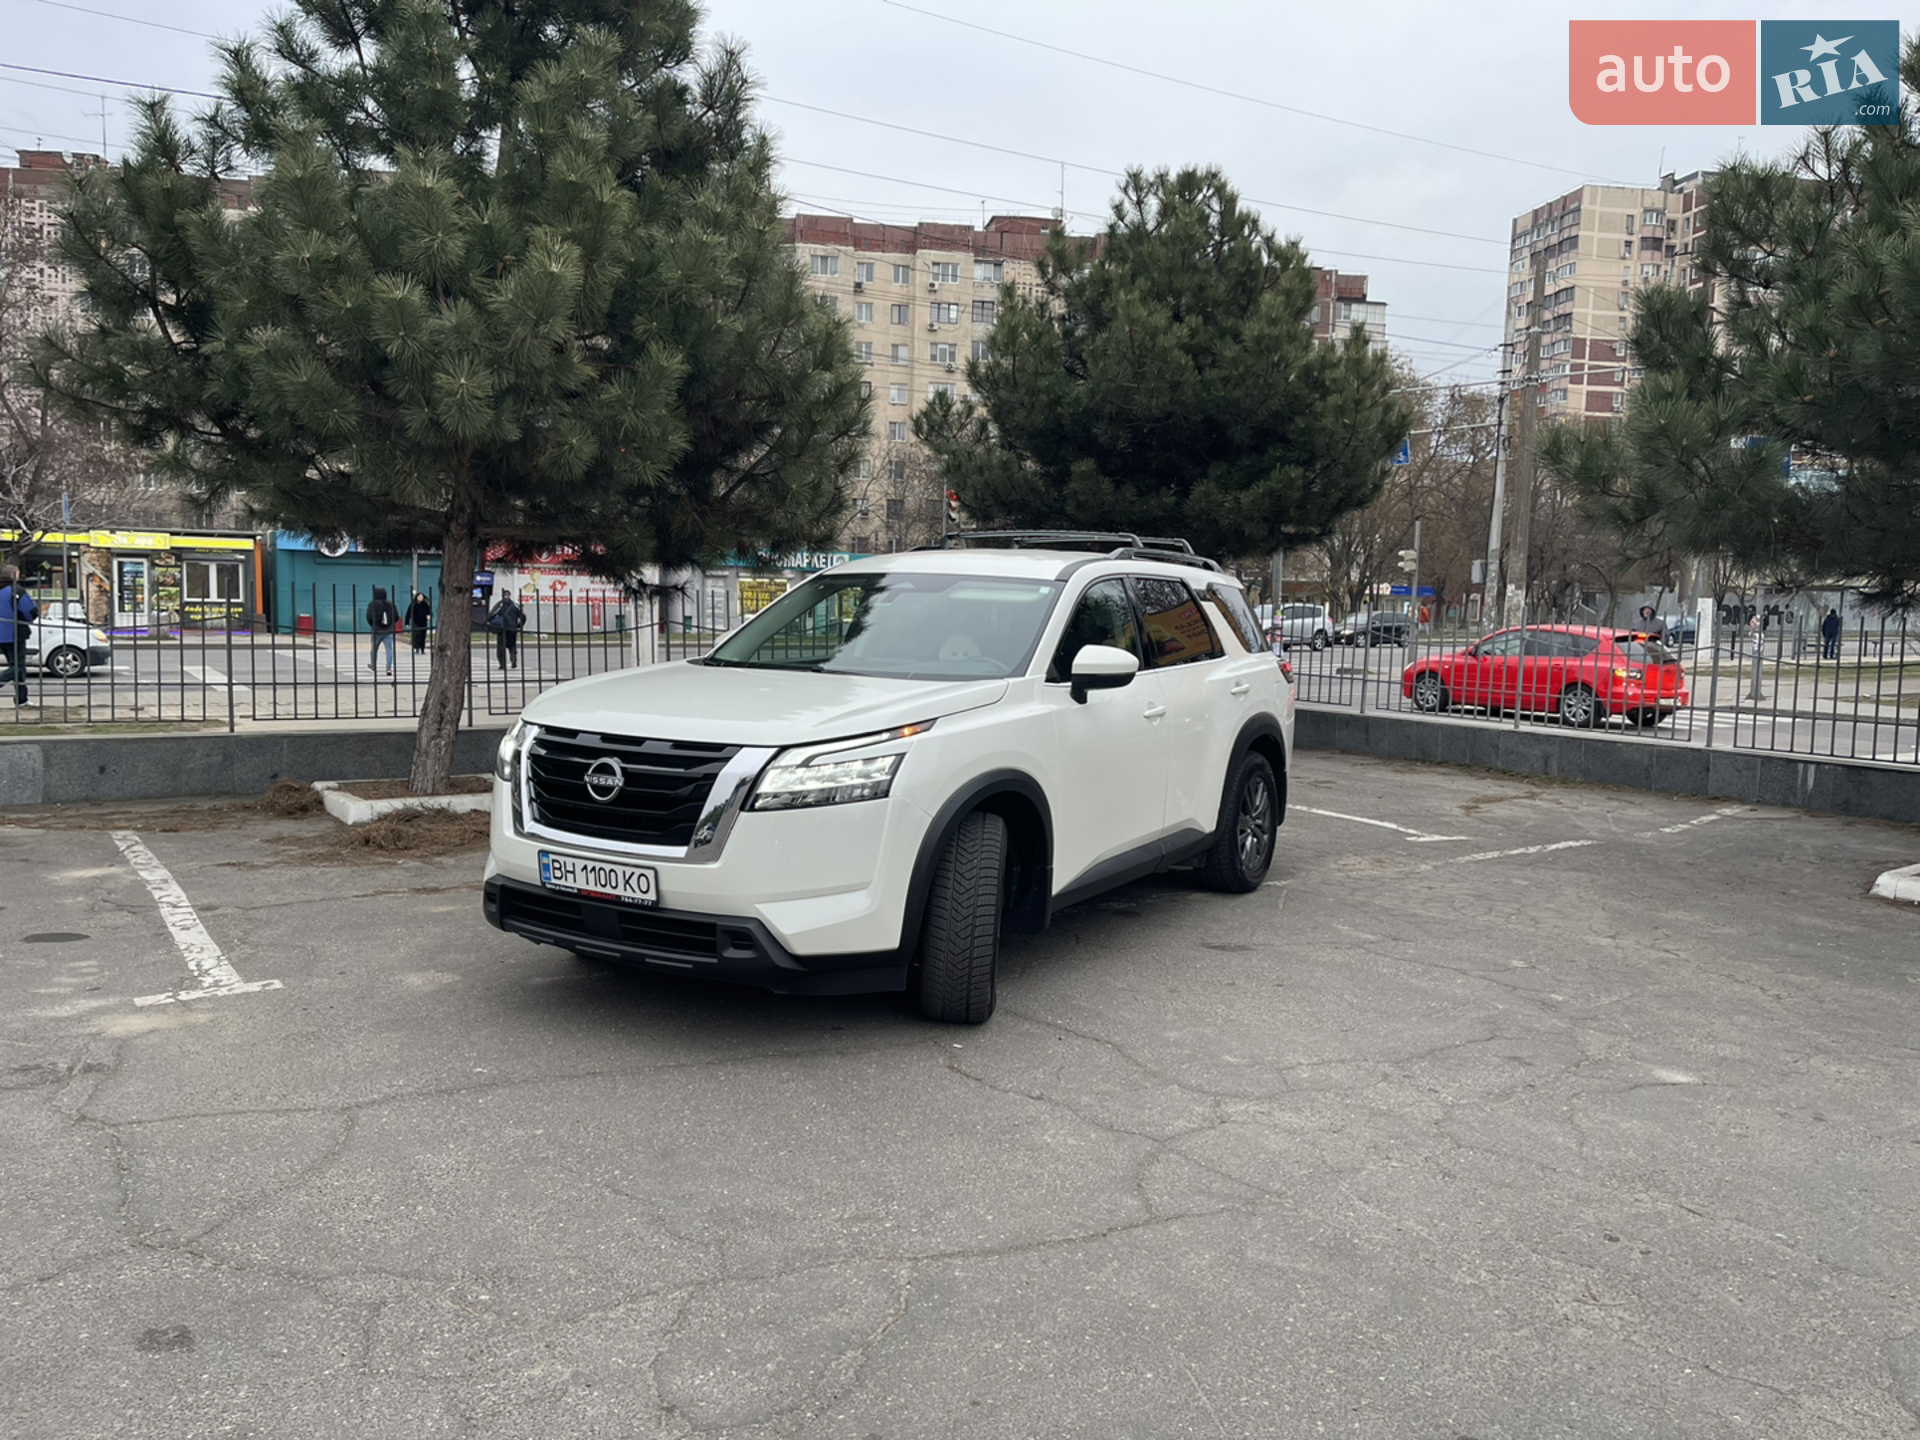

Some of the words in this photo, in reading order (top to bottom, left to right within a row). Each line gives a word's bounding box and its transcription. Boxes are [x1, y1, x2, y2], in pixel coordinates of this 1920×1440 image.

[584, 775, 624, 787] NISSAN
[551, 858, 577, 883] BH
[581, 864, 619, 890] 1100
[622, 870, 651, 895] KO
